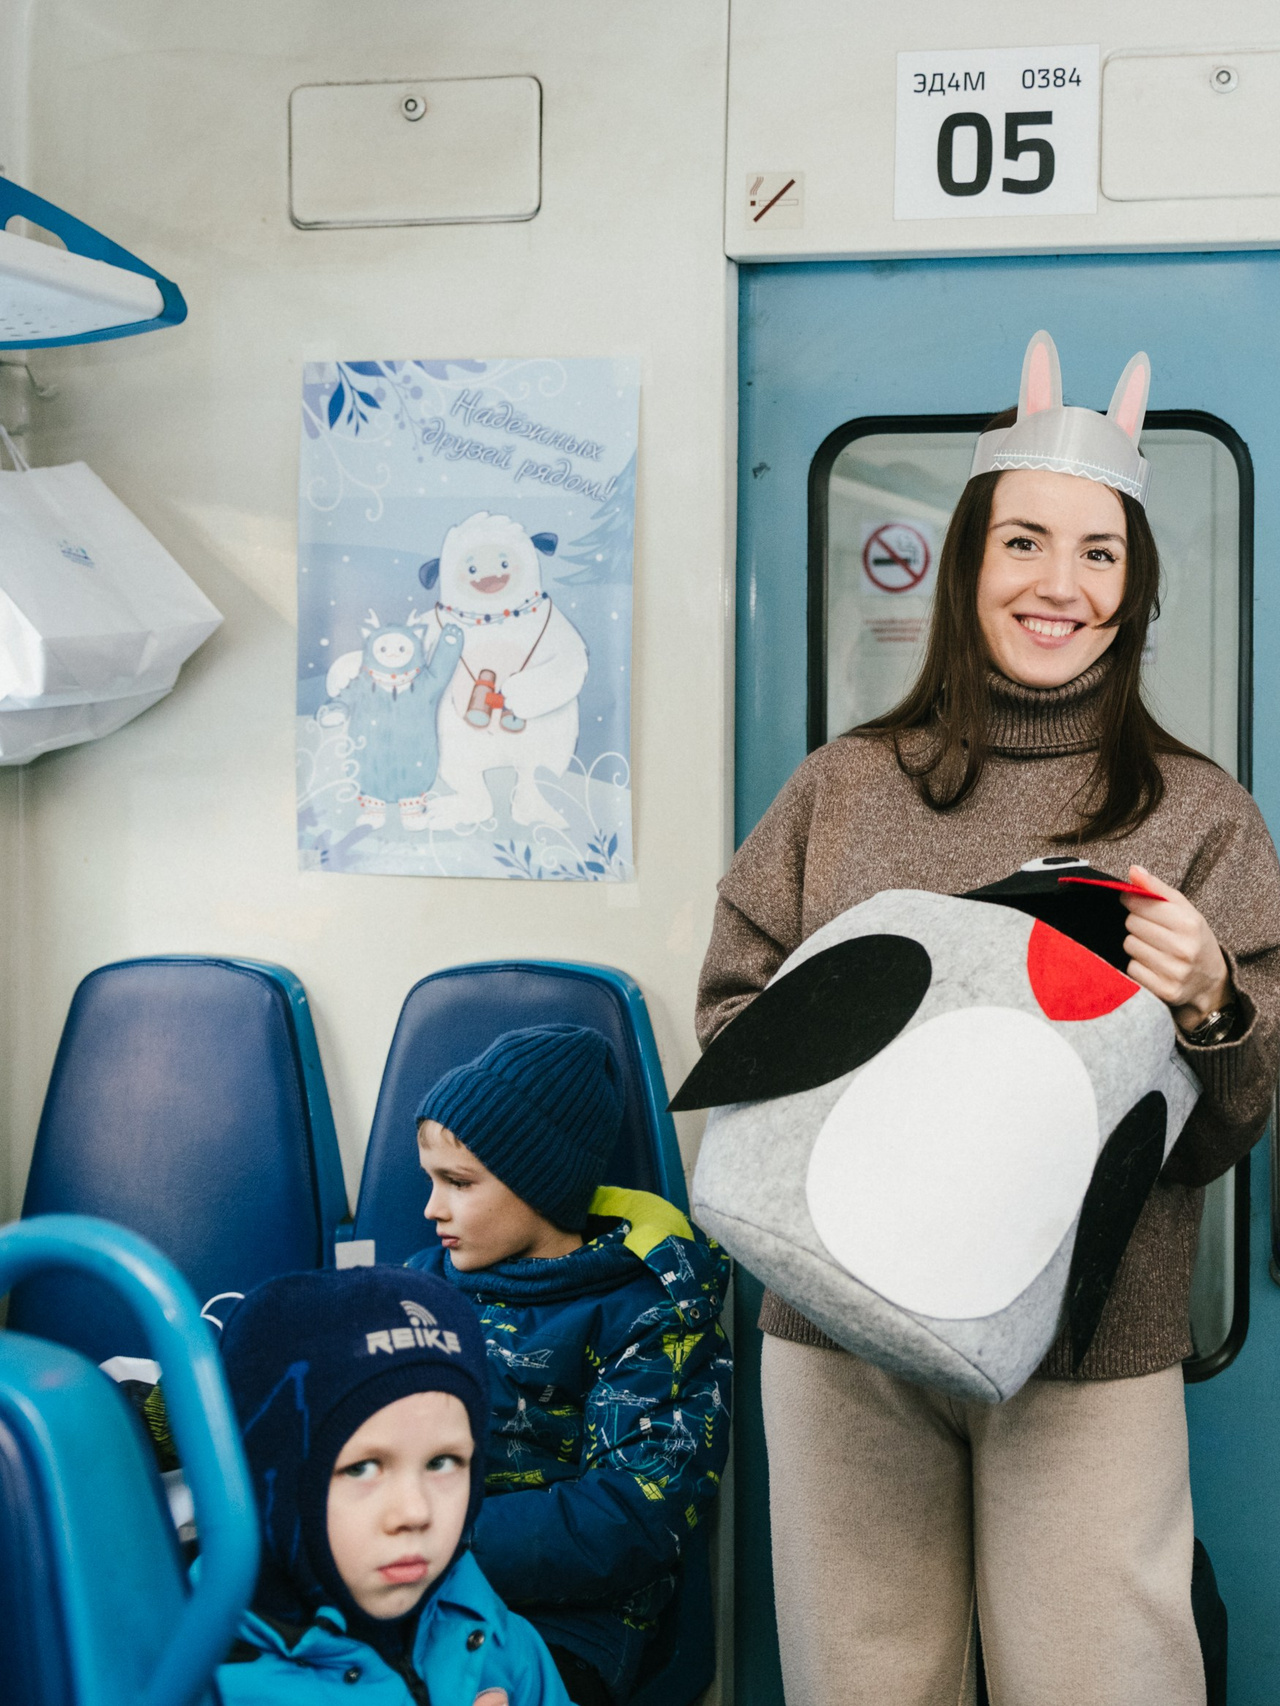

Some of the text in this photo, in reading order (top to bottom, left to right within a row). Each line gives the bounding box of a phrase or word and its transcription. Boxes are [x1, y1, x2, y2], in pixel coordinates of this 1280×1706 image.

[913, 68, 1081, 96] ЭД4М 0384
[937, 111, 1055, 197] 05
[422, 417, 618, 503] друзей рядом!
[451, 388, 606, 461] Надёжных
